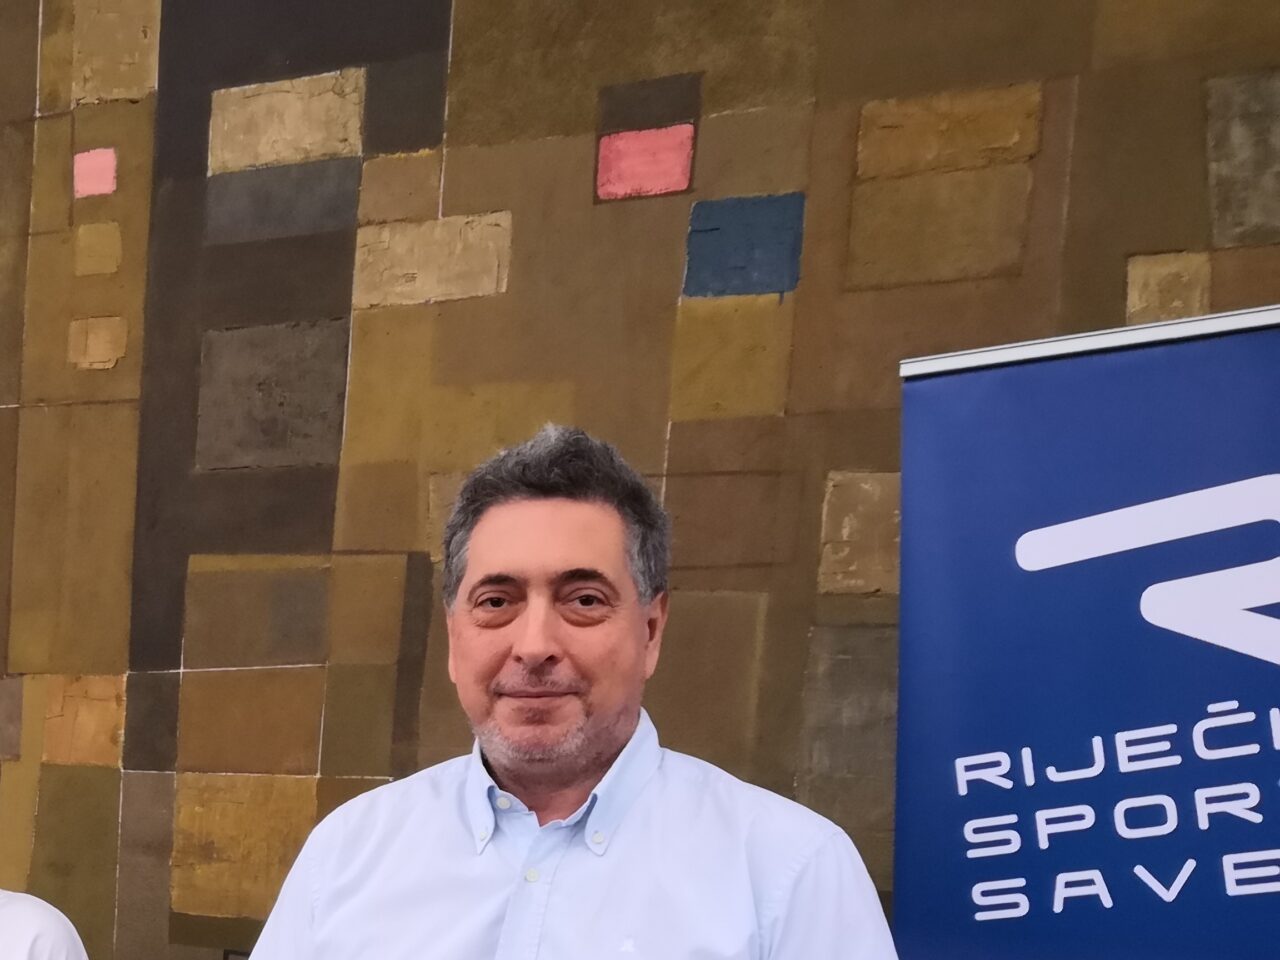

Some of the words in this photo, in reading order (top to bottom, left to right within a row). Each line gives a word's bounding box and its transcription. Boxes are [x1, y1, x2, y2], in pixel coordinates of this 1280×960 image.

[954, 700, 1280, 796] RIJEČ
[963, 782, 1280, 859] SPOR
[971, 849, 1280, 921] SAVE
